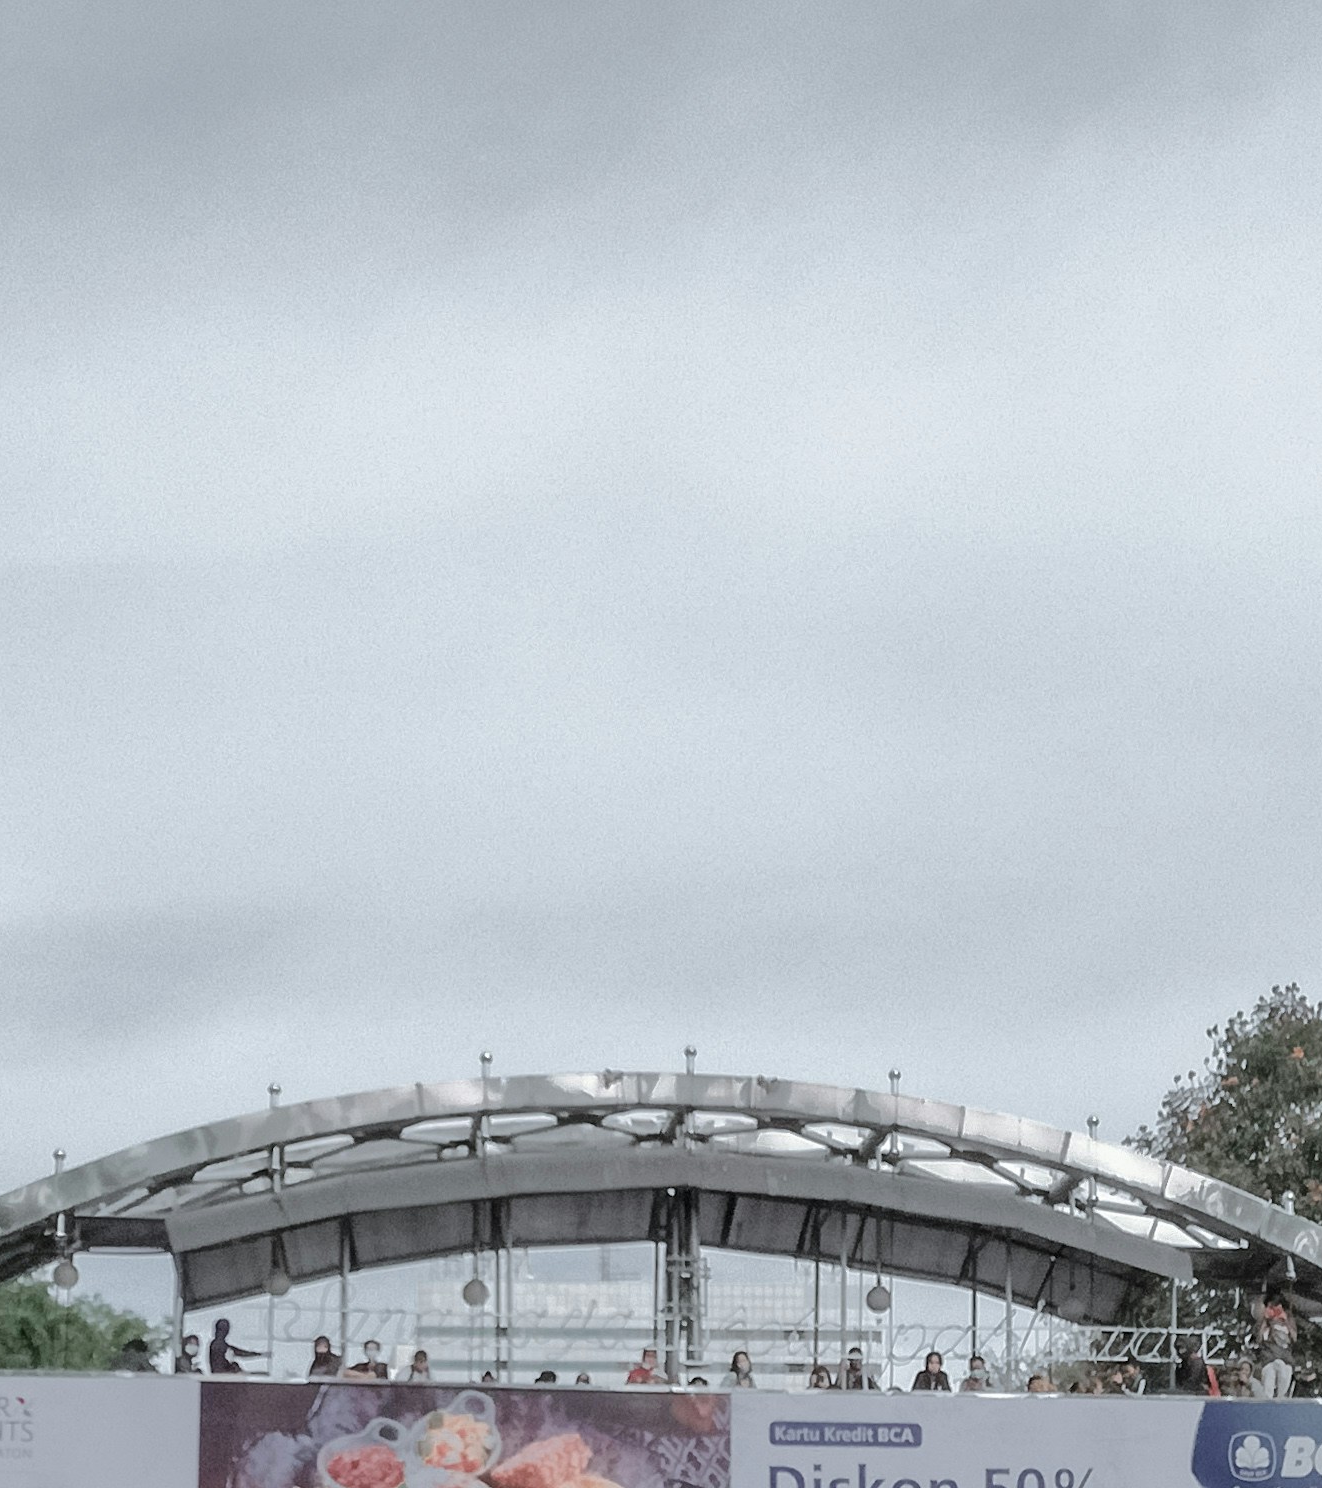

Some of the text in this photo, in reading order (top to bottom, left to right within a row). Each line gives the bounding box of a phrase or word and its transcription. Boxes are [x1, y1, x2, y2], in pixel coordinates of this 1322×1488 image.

[774, 1425, 915, 1444] Kartu Kredit BCA
